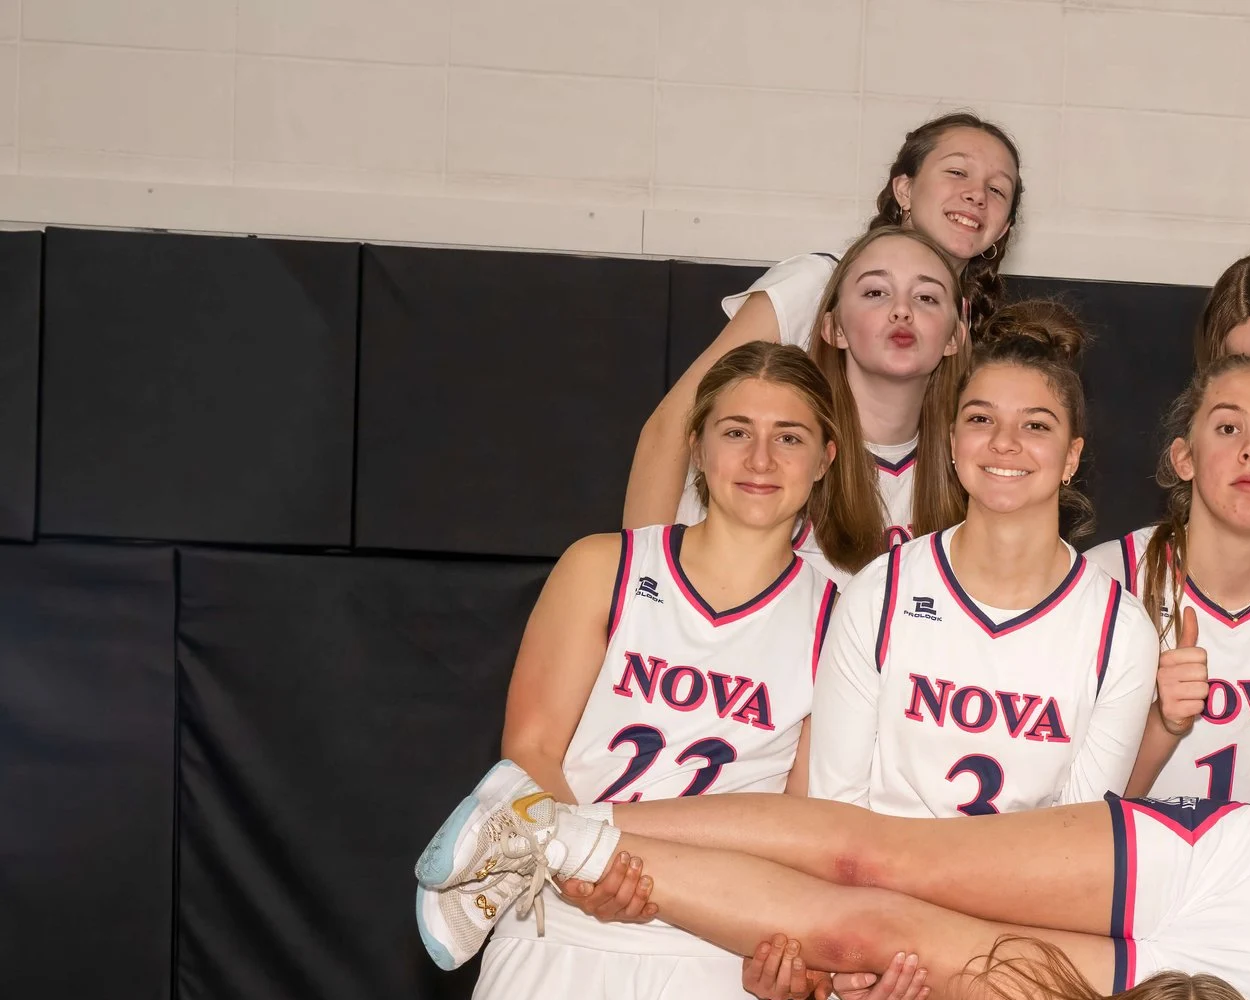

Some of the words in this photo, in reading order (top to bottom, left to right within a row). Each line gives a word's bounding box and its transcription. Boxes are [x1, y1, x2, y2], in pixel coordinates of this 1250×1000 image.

[903, 610, 943, 622] PROLOOK
[613, 651, 775, 731] NOVA
[904, 673, 1071, 743] NOVA
